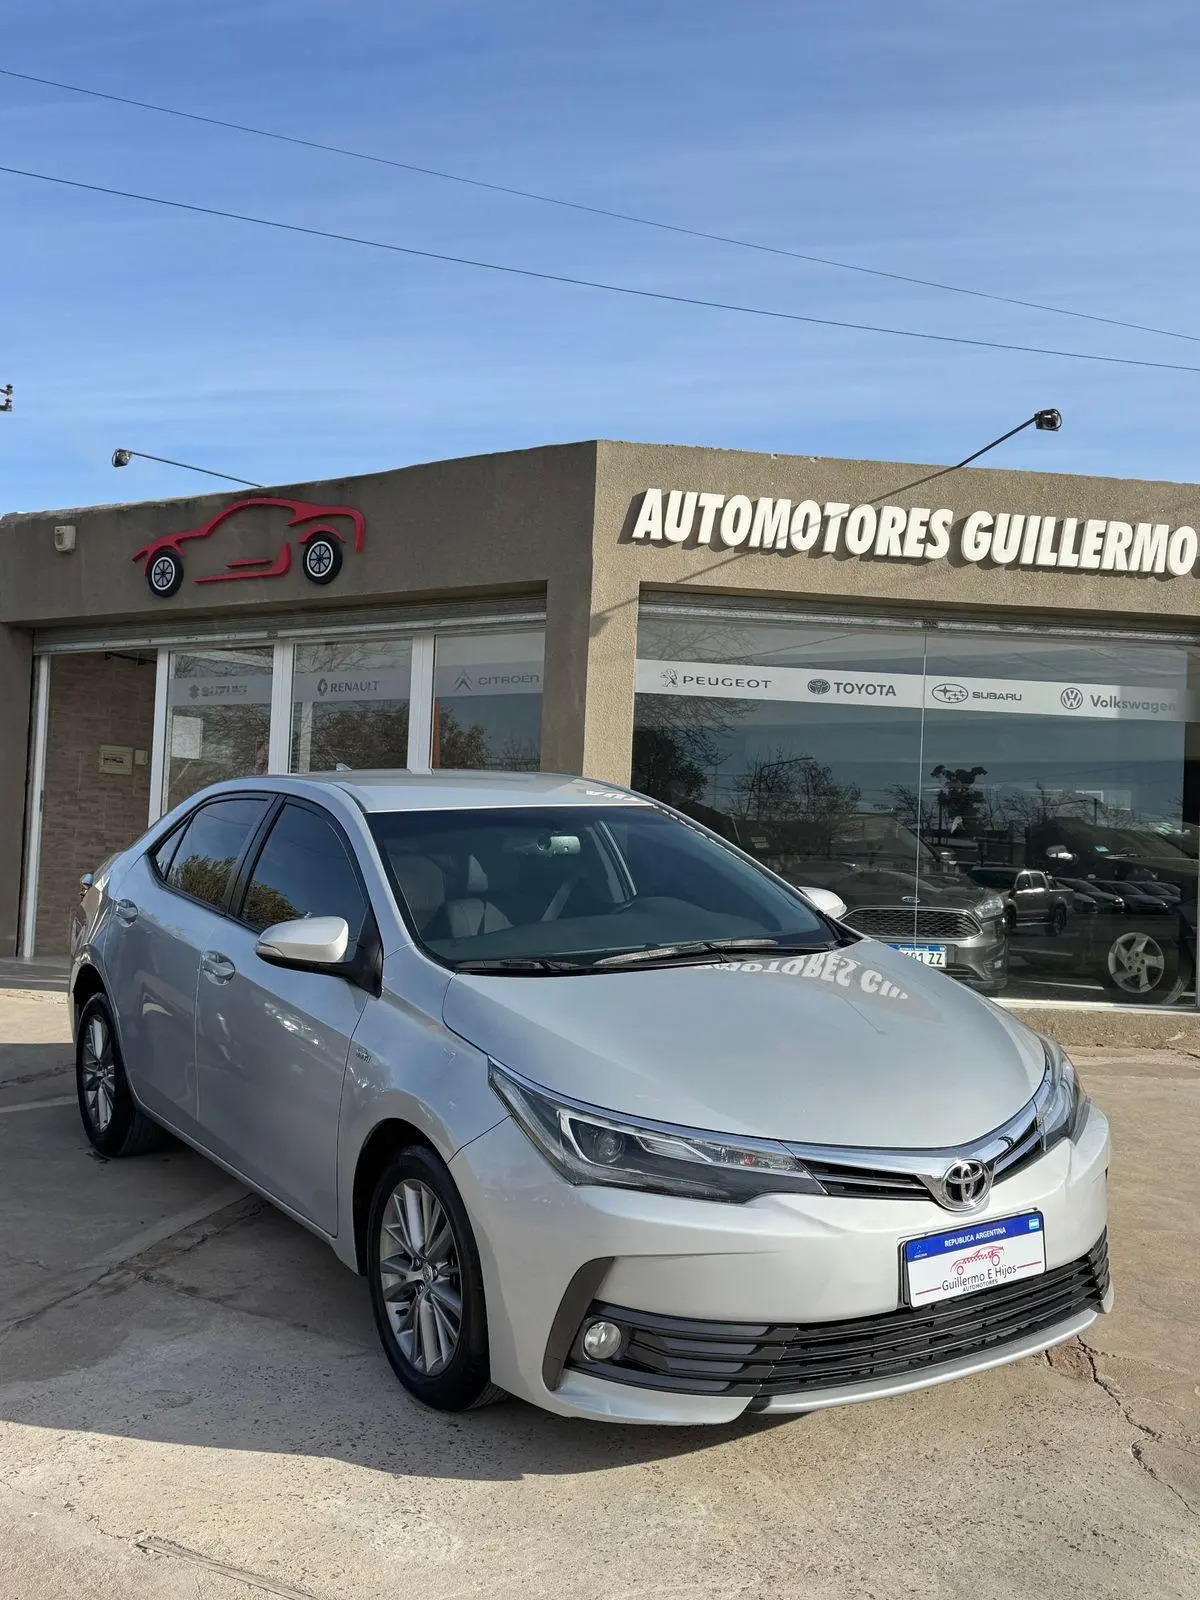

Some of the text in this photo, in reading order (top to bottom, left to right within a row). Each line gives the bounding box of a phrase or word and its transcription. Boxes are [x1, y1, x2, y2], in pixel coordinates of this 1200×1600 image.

[632, 488, 1198, 577] AUTOMOTORES GUILLERMO
[330, 680, 379, 693] RENAULT
[683, 675, 772, 689] PEUGEOT
[834, 682, 896, 696] TOYOTA
[972, 691, 1022, 701] SUBARU
[1090, 695, 1176, 713] Volkswagen
[929, 953, 942, 965] ZZ
[944, 1226, 1006, 1247] REPUBLICA ARGENTINA
[942, 1264, 1017, 1291] Guillermo E Hijos
